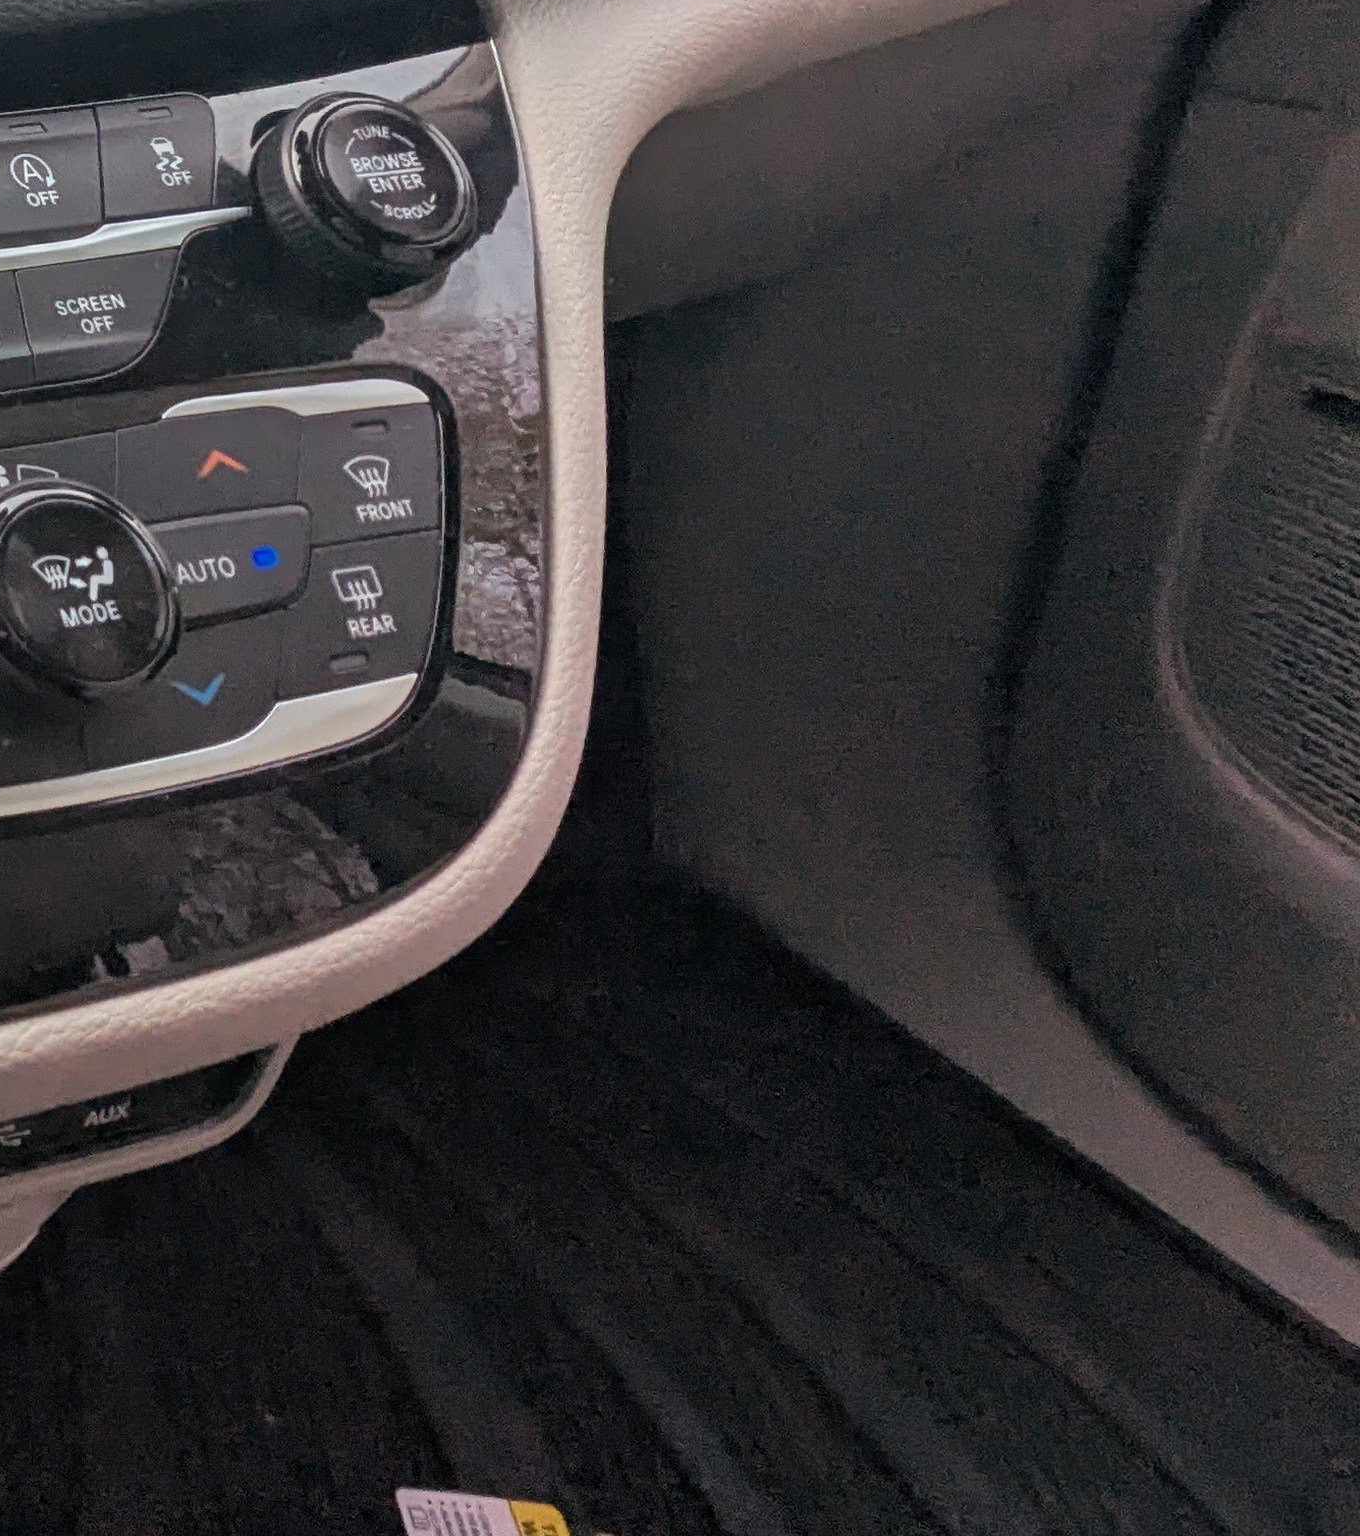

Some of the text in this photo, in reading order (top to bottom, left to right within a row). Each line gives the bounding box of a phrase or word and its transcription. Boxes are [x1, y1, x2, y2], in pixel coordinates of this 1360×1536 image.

[353, 124, 393, 140] TUNE
[349, 150, 422, 173] BROWSE
[161, 170, 192, 187] OFF
[368, 173, 427, 194] ENTER
[26, 190, 60, 207] OFF
[383, 200, 436, 220] SCROLL
[54, 293, 127, 317] SCREEN
[80, 316, 115, 335] OFF
[356, 498, 414, 523] FRONT
[175, 558, 237, 585] AUTO
[59, 600, 122, 629] MODE
[346, 614, 398, 638] REAR
[84, 1103, 133, 1128] AUX
